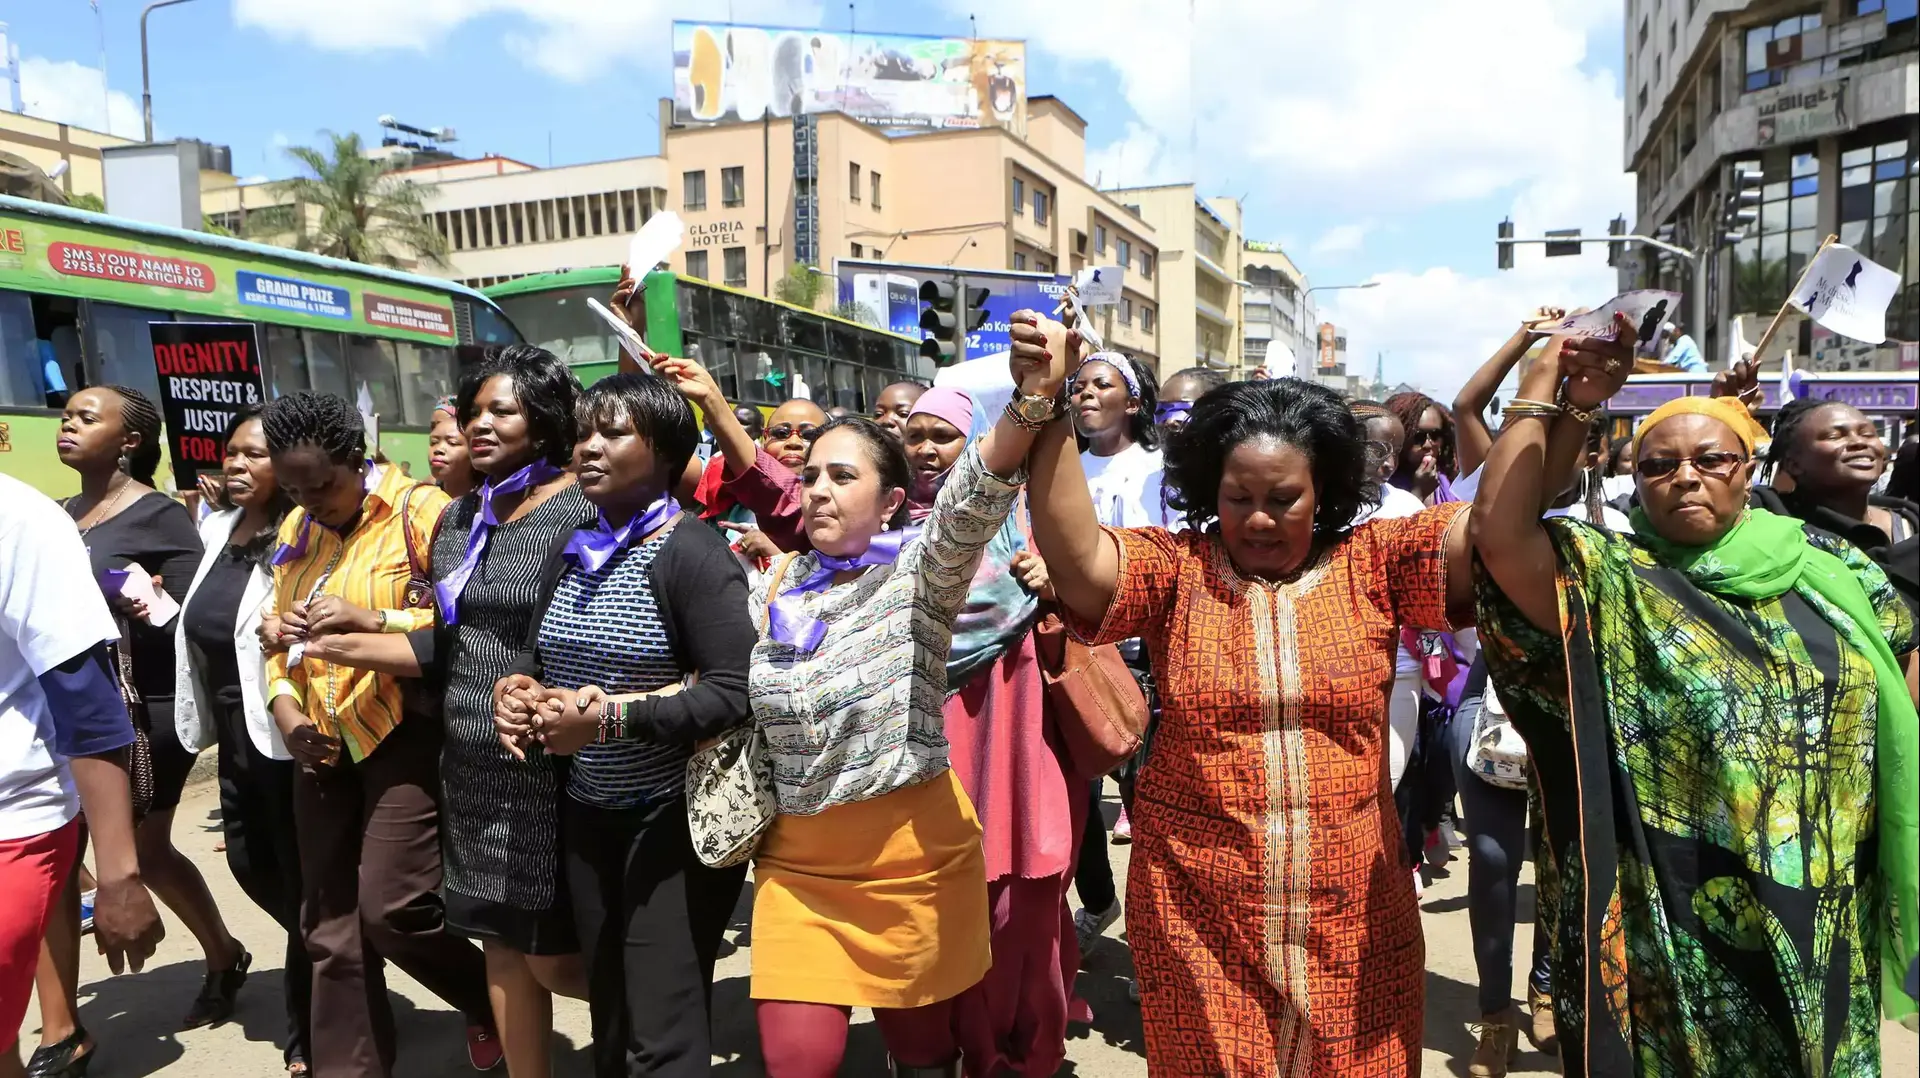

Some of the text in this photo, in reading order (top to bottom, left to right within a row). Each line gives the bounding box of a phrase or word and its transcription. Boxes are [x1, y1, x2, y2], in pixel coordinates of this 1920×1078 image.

[690, 221, 744, 235] GLORIA
[692, 233, 739, 247] HOTEL
[63, 247, 202, 278] SMS YOUR NAME TO
[63, 259, 205, 288] 29555 TO PARTICIPATE
[256, 278, 335, 305] GRAND PRIZE
[1815, 276, 1828, 293] My
[1819, 293, 1832, 310] My
[154, 340, 260, 376] DIGNITY,
[169, 376, 259, 404] RESPECT &
[184, 408, 236, 433] JUSTI
[179, 436, 218, 462] FOR
